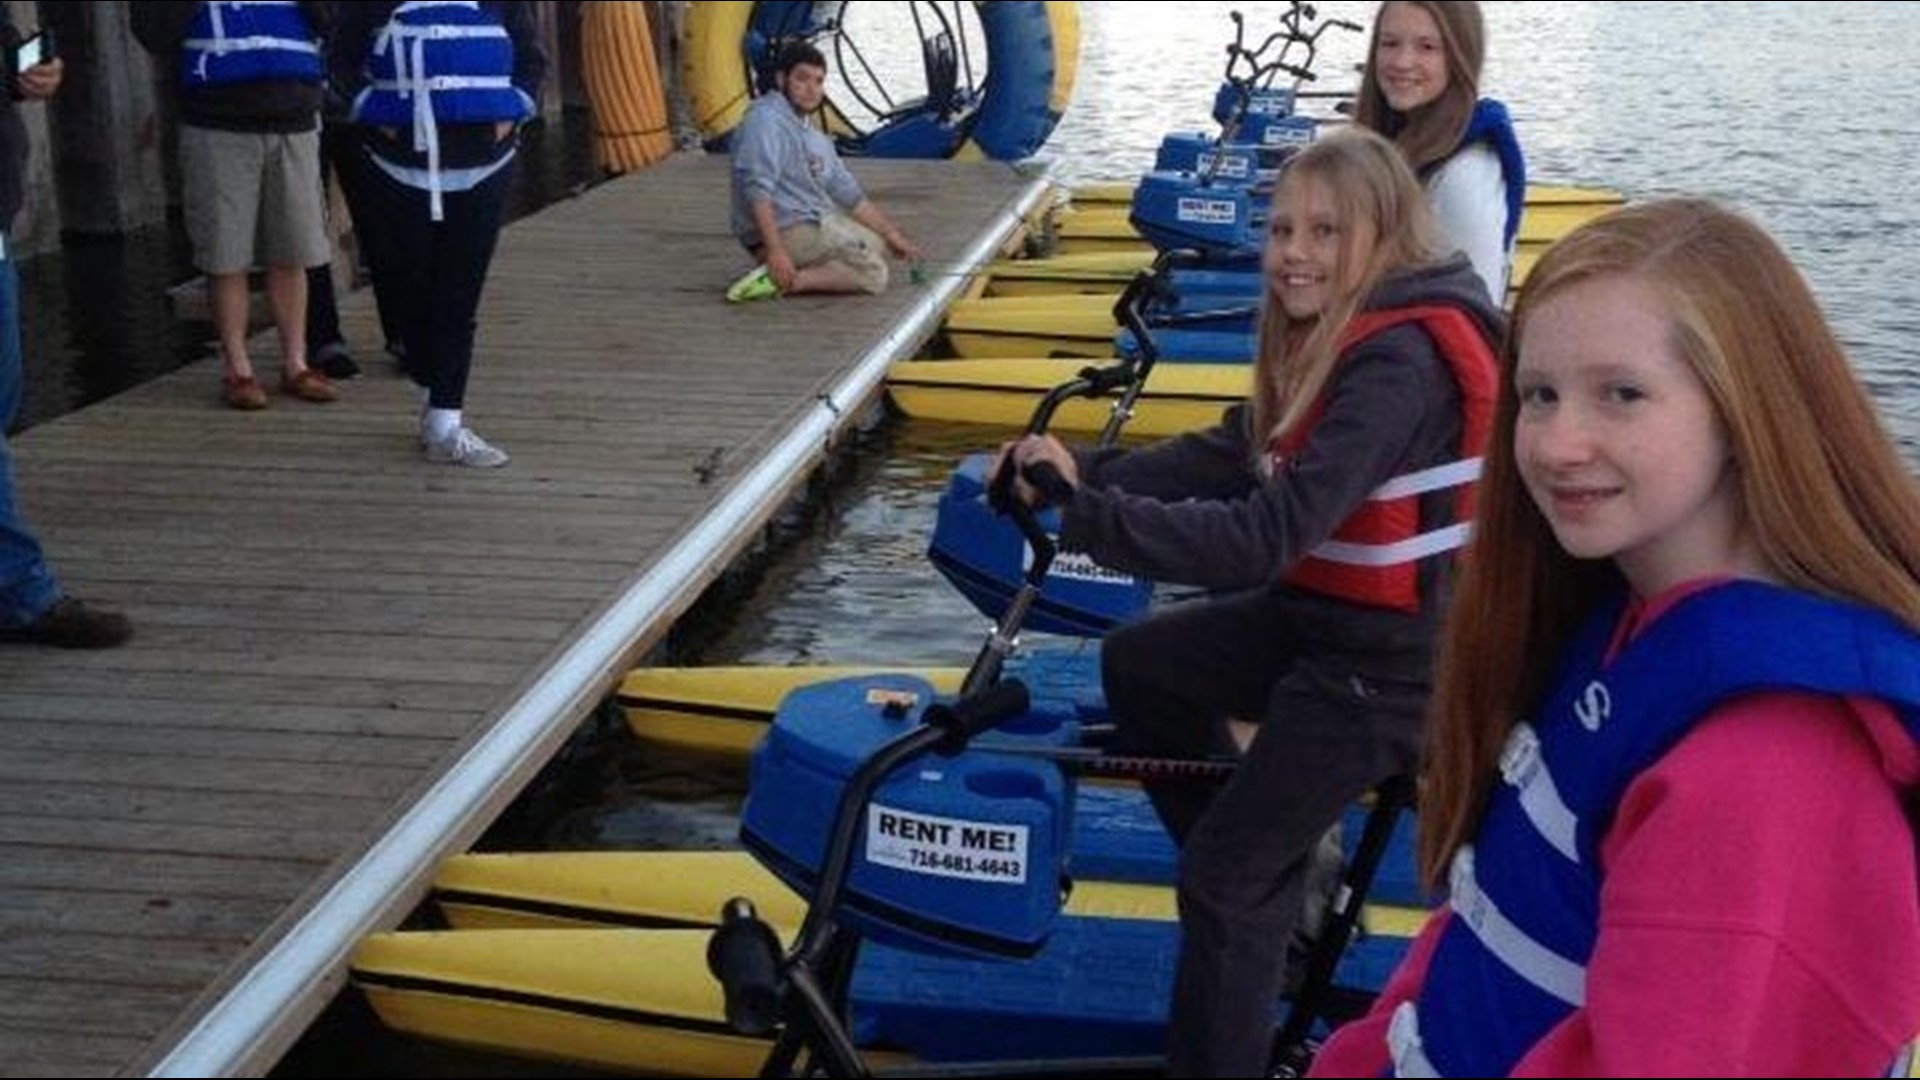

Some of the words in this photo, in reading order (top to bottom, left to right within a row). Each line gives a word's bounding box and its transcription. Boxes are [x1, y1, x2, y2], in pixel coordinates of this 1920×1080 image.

[1574, 680, 1611, 732] S
[879, 813, 953, 846] RENT
[961, 826, 1017, 851] ME!
[909, 849, 1021, 877] 716-681-4643
